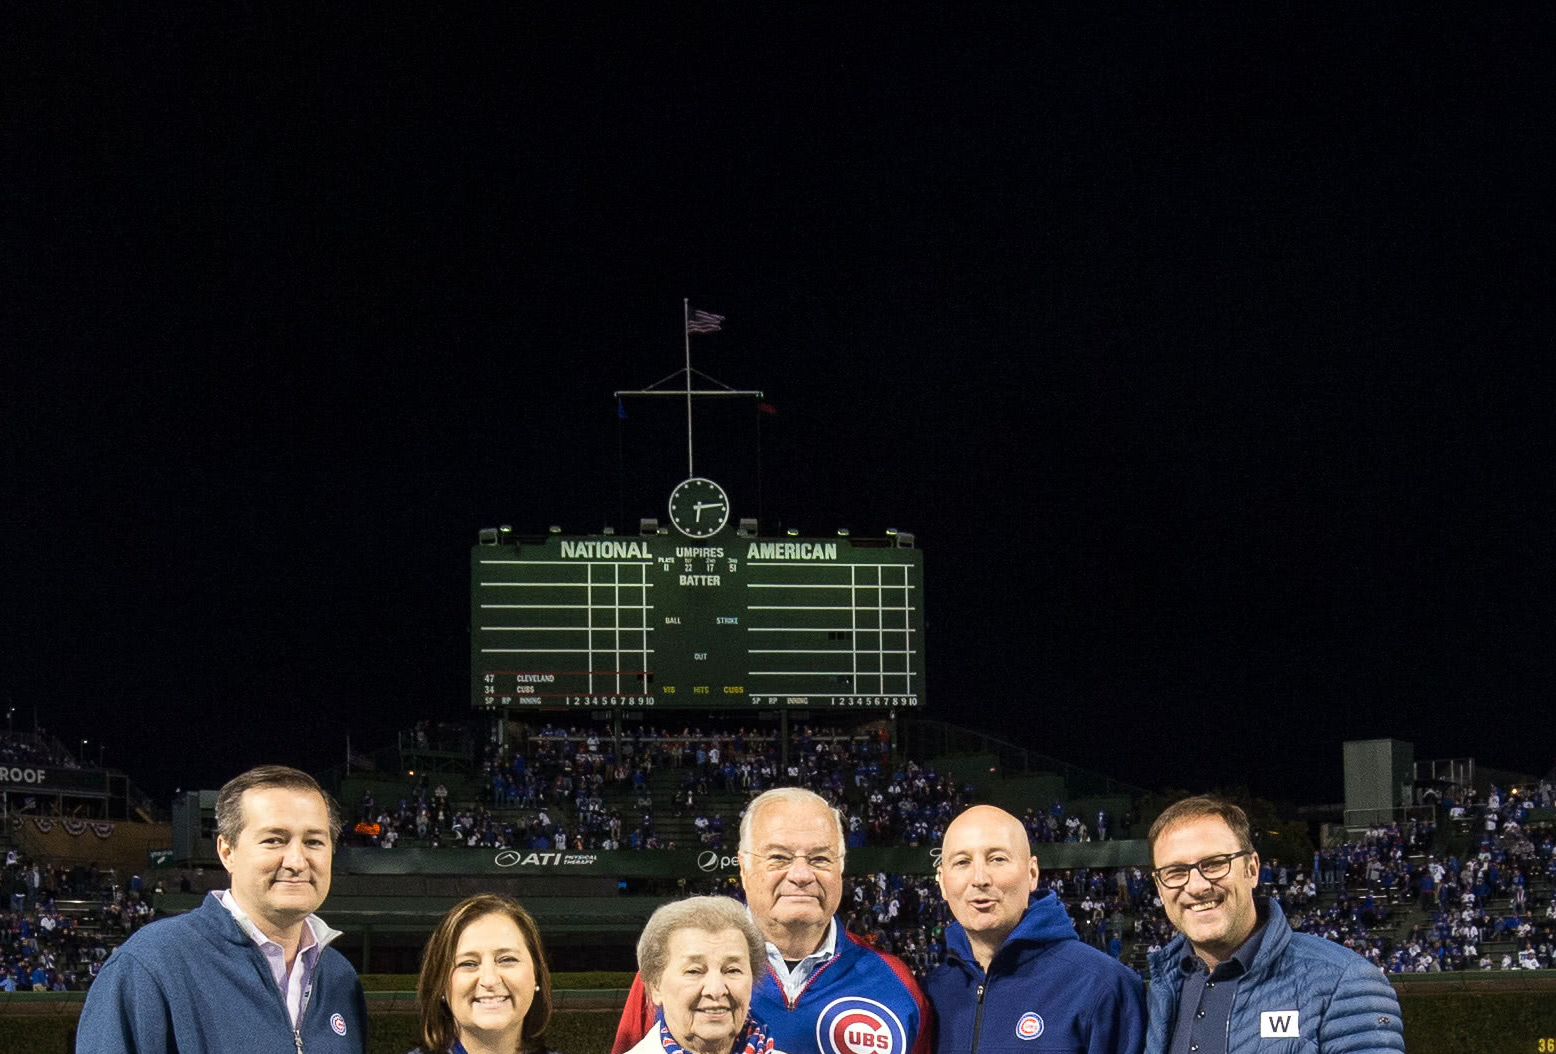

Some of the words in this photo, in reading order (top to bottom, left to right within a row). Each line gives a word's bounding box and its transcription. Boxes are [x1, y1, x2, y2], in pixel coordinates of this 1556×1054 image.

[560, 541, 652, 559] NATIONAL
[676, 547, 724, 558] UMPIRES
[747, 543, 837, 560] AMERICAN
[679, 575, 721, 586] BATTER
[484, 675, 495, 683] 47
[484, 686, 495, 694] 34
[566, 697, 570, 705] 1
[574, 697, 580, 705] 2
[584, 697, 590, 705] 3
[592, 697, 598, 705] 4
[602, 697, 607, 705] 5
[611, 697, 617, 705] 6
[620, 697, 626, 705] 7
[629, 697, 635, 705] 8
[638, 697, 644, 705] 9
[646, 697, 654, 705] 10
[521, 853, 561, 866] ATI
[1269, 1016, 1291, 1032] W
